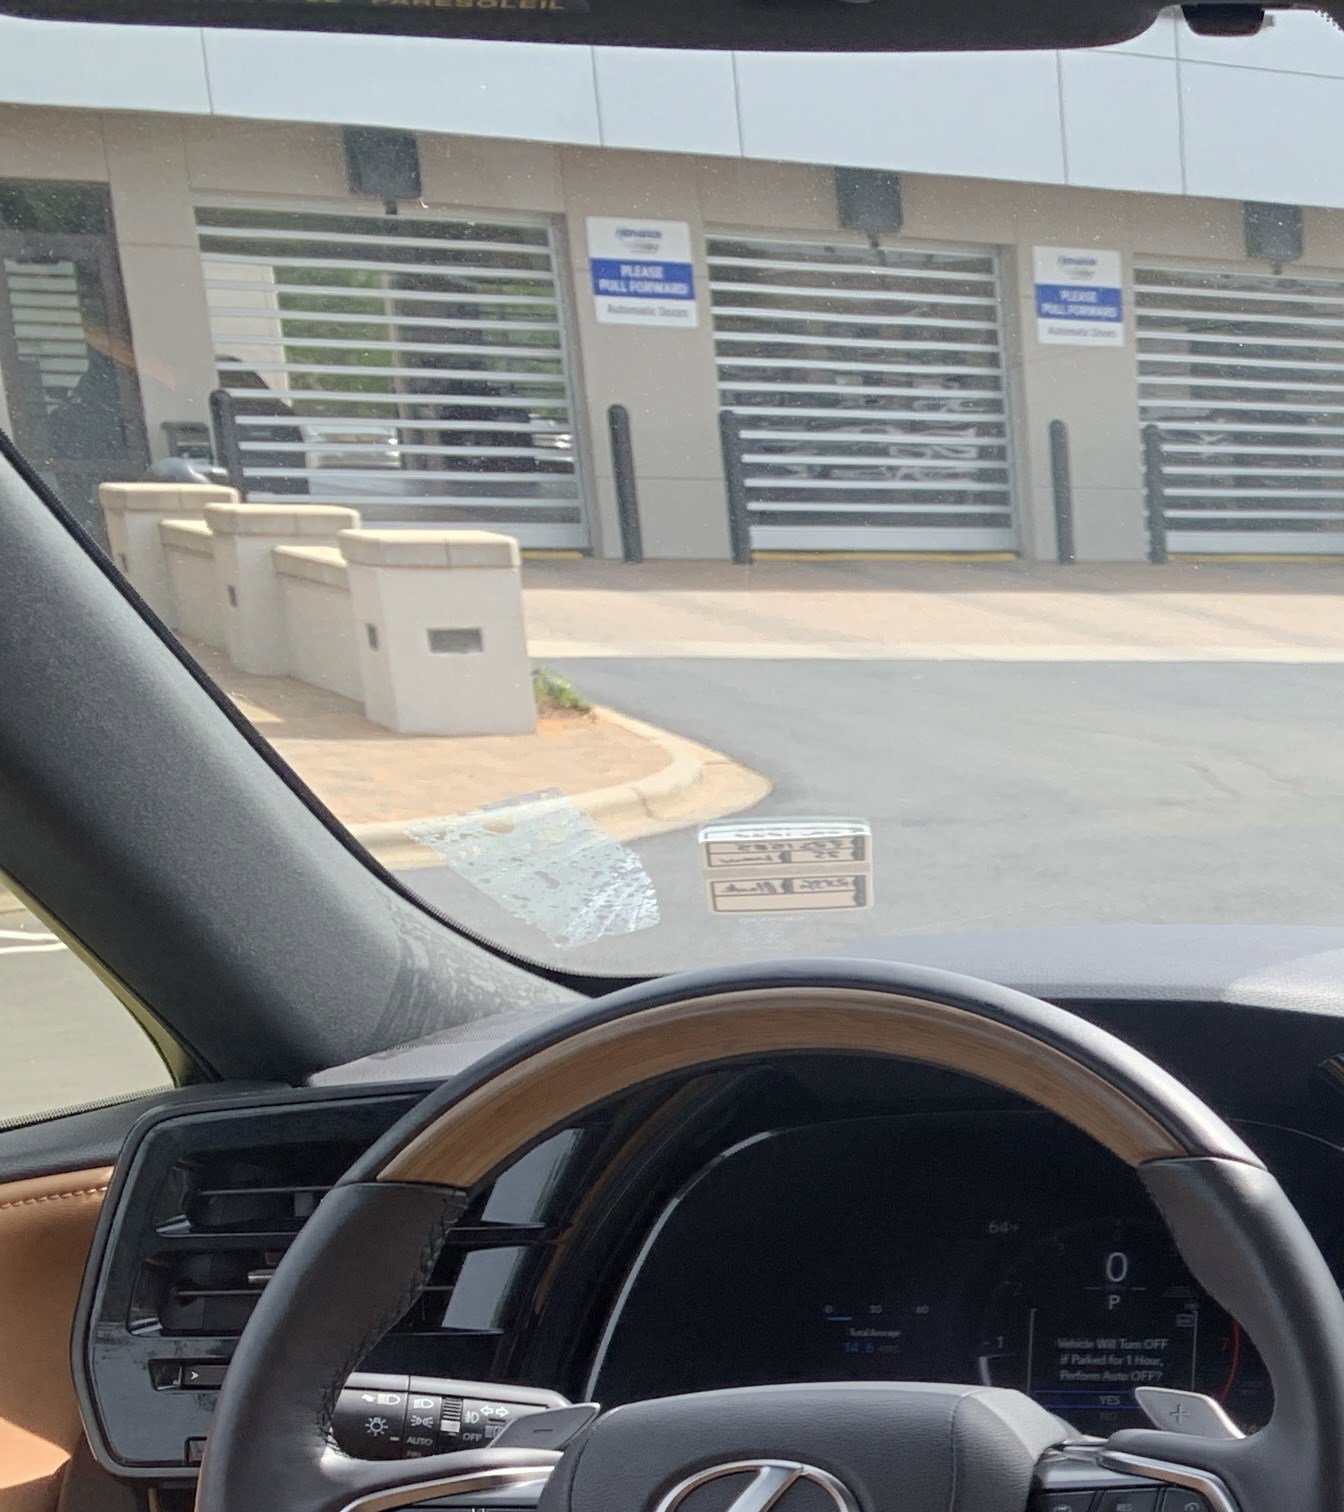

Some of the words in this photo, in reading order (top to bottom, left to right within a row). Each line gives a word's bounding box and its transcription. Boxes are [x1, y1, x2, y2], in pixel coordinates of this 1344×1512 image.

[1106, 1251, 1128, 1283] 0
[1107, 1294, 1121, 1311] P
[1057, 1338, 1095, 1350] Vehicle
[1096, 1338, 1117, 1350] Will
[1120, 1338, 1142, 1350] Turn
[1143, 1338, 1169, 1350] OFF
[1071, 1354, 1107, 1366] Parked
[1131, 1370, 1163, 1382] OFF?
[406, 1436, 434, 1447] AUTO
[463, 1433, 482, 1442] OFF
